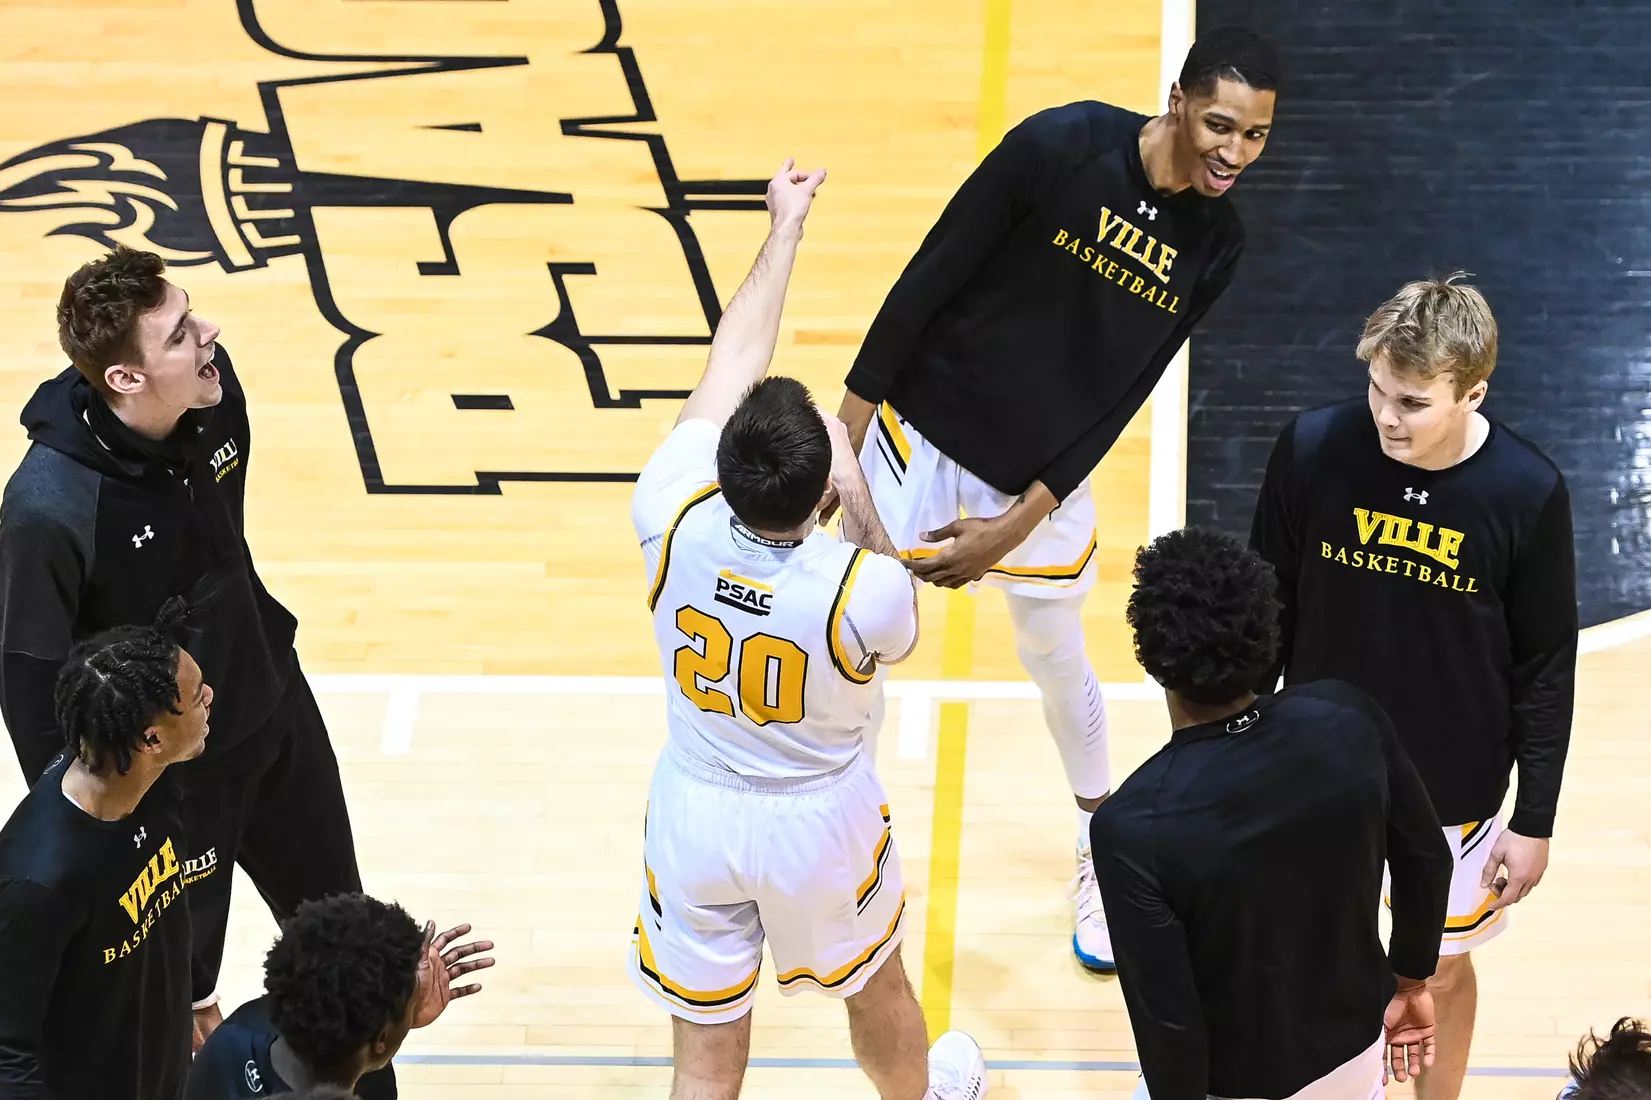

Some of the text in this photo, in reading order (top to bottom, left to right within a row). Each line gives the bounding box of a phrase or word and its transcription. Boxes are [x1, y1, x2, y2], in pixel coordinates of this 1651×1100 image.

[1052, 228, 1180, 314] BASKETBALL
[1096, 206, 1178, 284] VILLE
[209, 438, 238, 473] VILL
[734, 524, 794, 547] ARMOUR
[1353, 507, 1465, 570] VILLE
[716, 577, 773, 610] PSAC
[1321, 541, 1479, 593] BASKETBALL
[673, 604, 809, 727] 20
[119, 836, 180, 925] VILLE
[181, 846, 218, 878] ILLE
